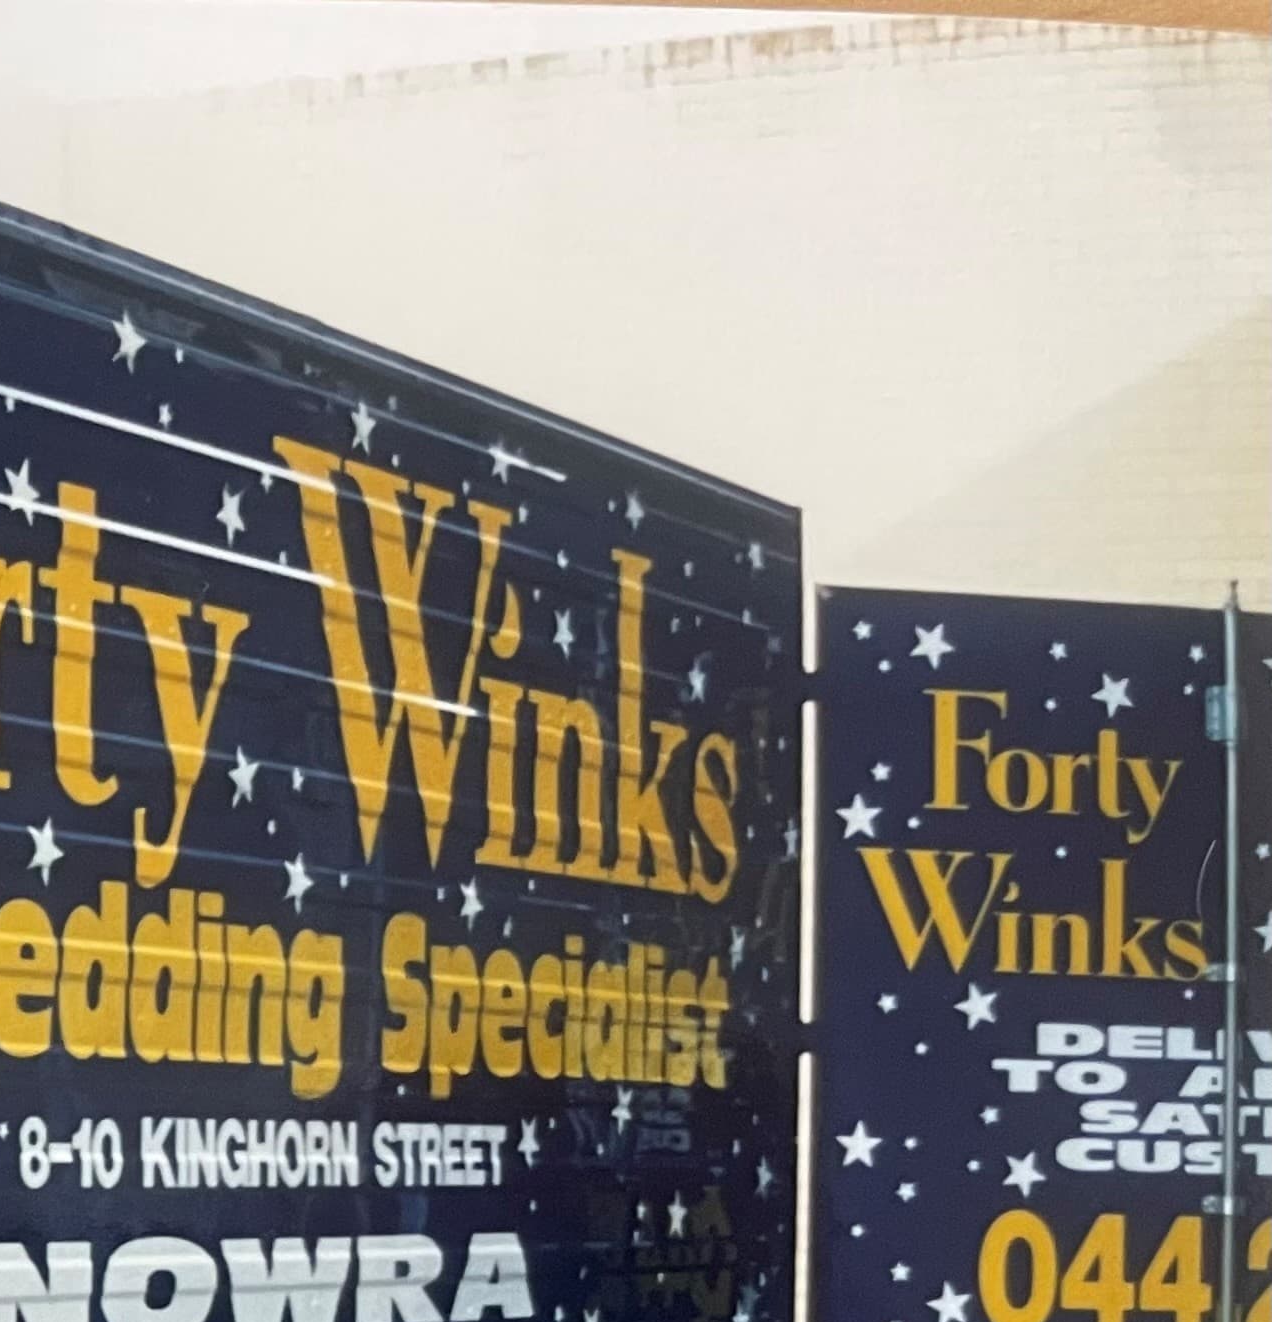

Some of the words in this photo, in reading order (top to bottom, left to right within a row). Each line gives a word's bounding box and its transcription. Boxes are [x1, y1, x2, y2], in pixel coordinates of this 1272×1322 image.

[273, 436, 739, 904] Winks
[923, 688, 1183, 844] Forty
[854, 847, 1208, 982] Winks
[381, 912, 731, 1100] Specialist
[991, 1059, 1128, 1095] TO
[19, 1116, 124, 1189] 8-10
[141, 1118, 361, 1188] KINGHORN
[374, 1124, 508, 1187] STREET
